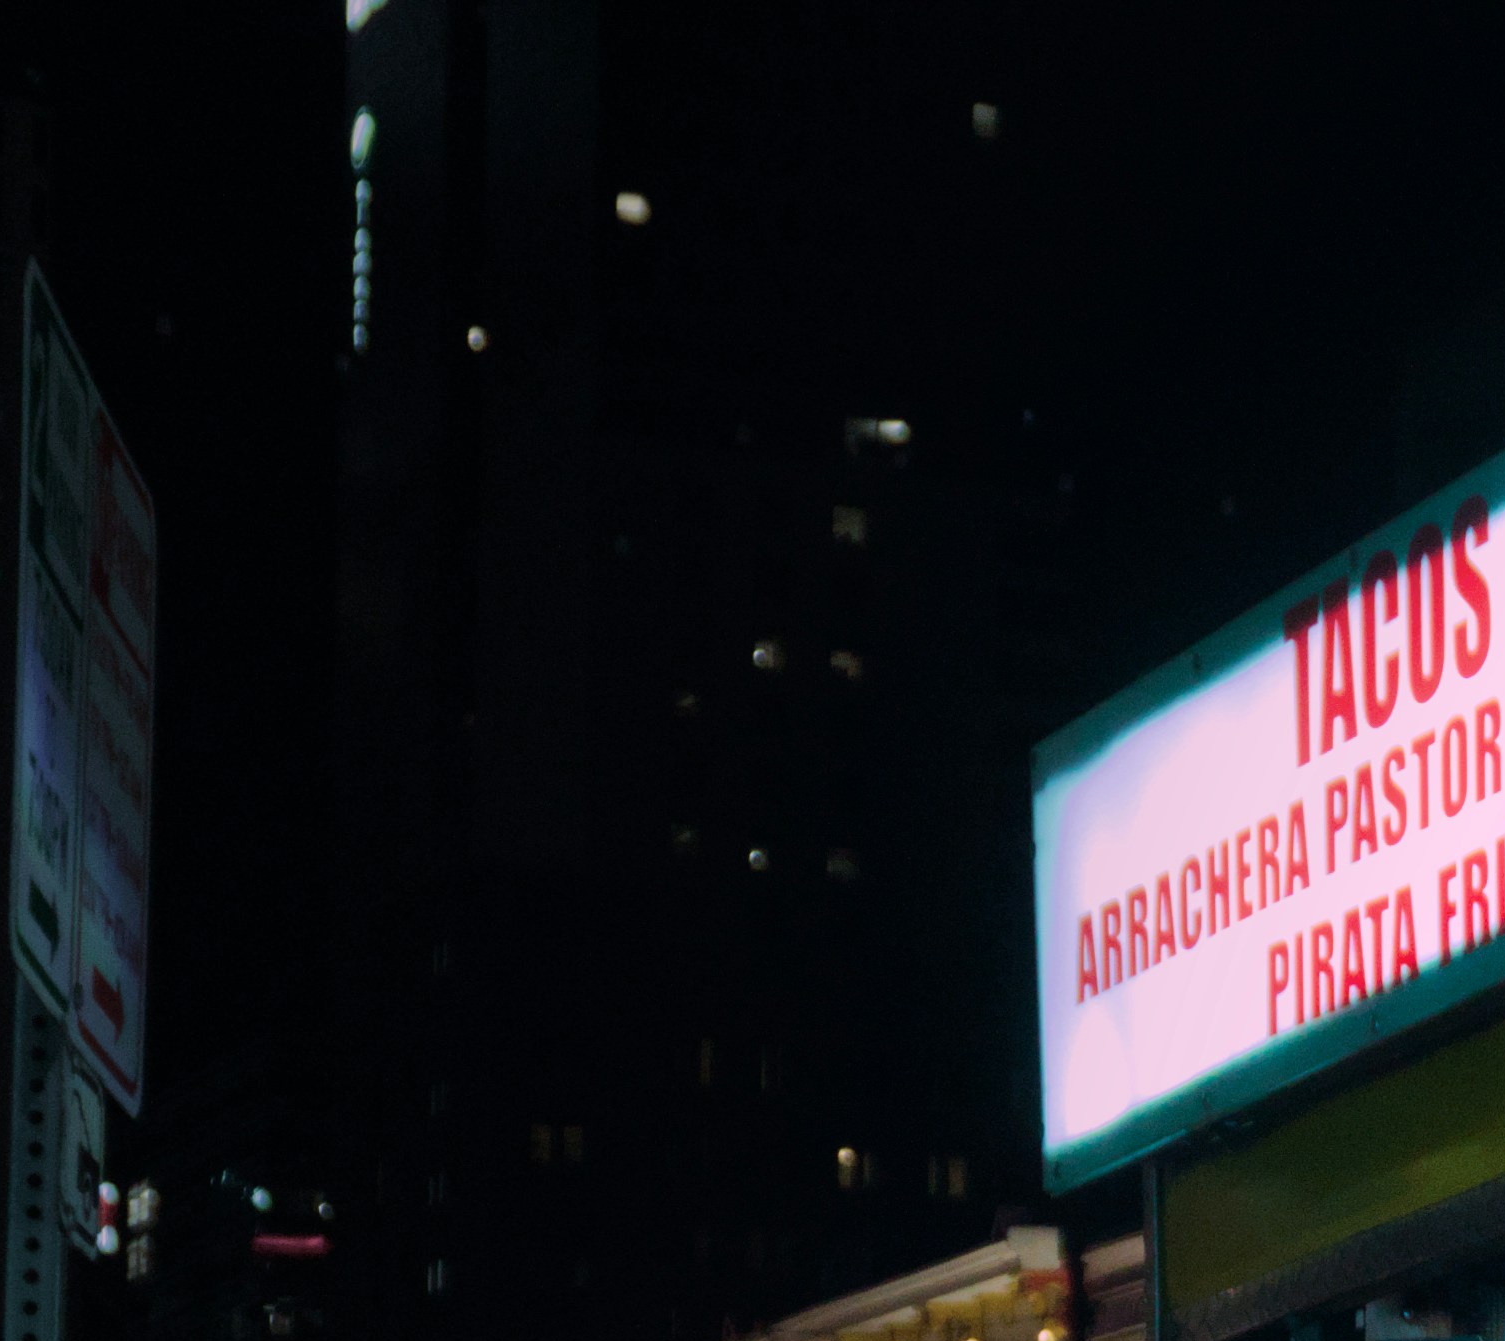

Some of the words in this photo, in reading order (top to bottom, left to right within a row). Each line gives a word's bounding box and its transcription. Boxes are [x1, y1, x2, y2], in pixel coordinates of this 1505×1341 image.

[1282, 494, 1492, 769] TACOS
[1076, 798, 1309, 1004] ARRACHERA
[1325, 696, 1501, 875] PASTOR
[1267, 885, 1420, 1037] PIRATA
